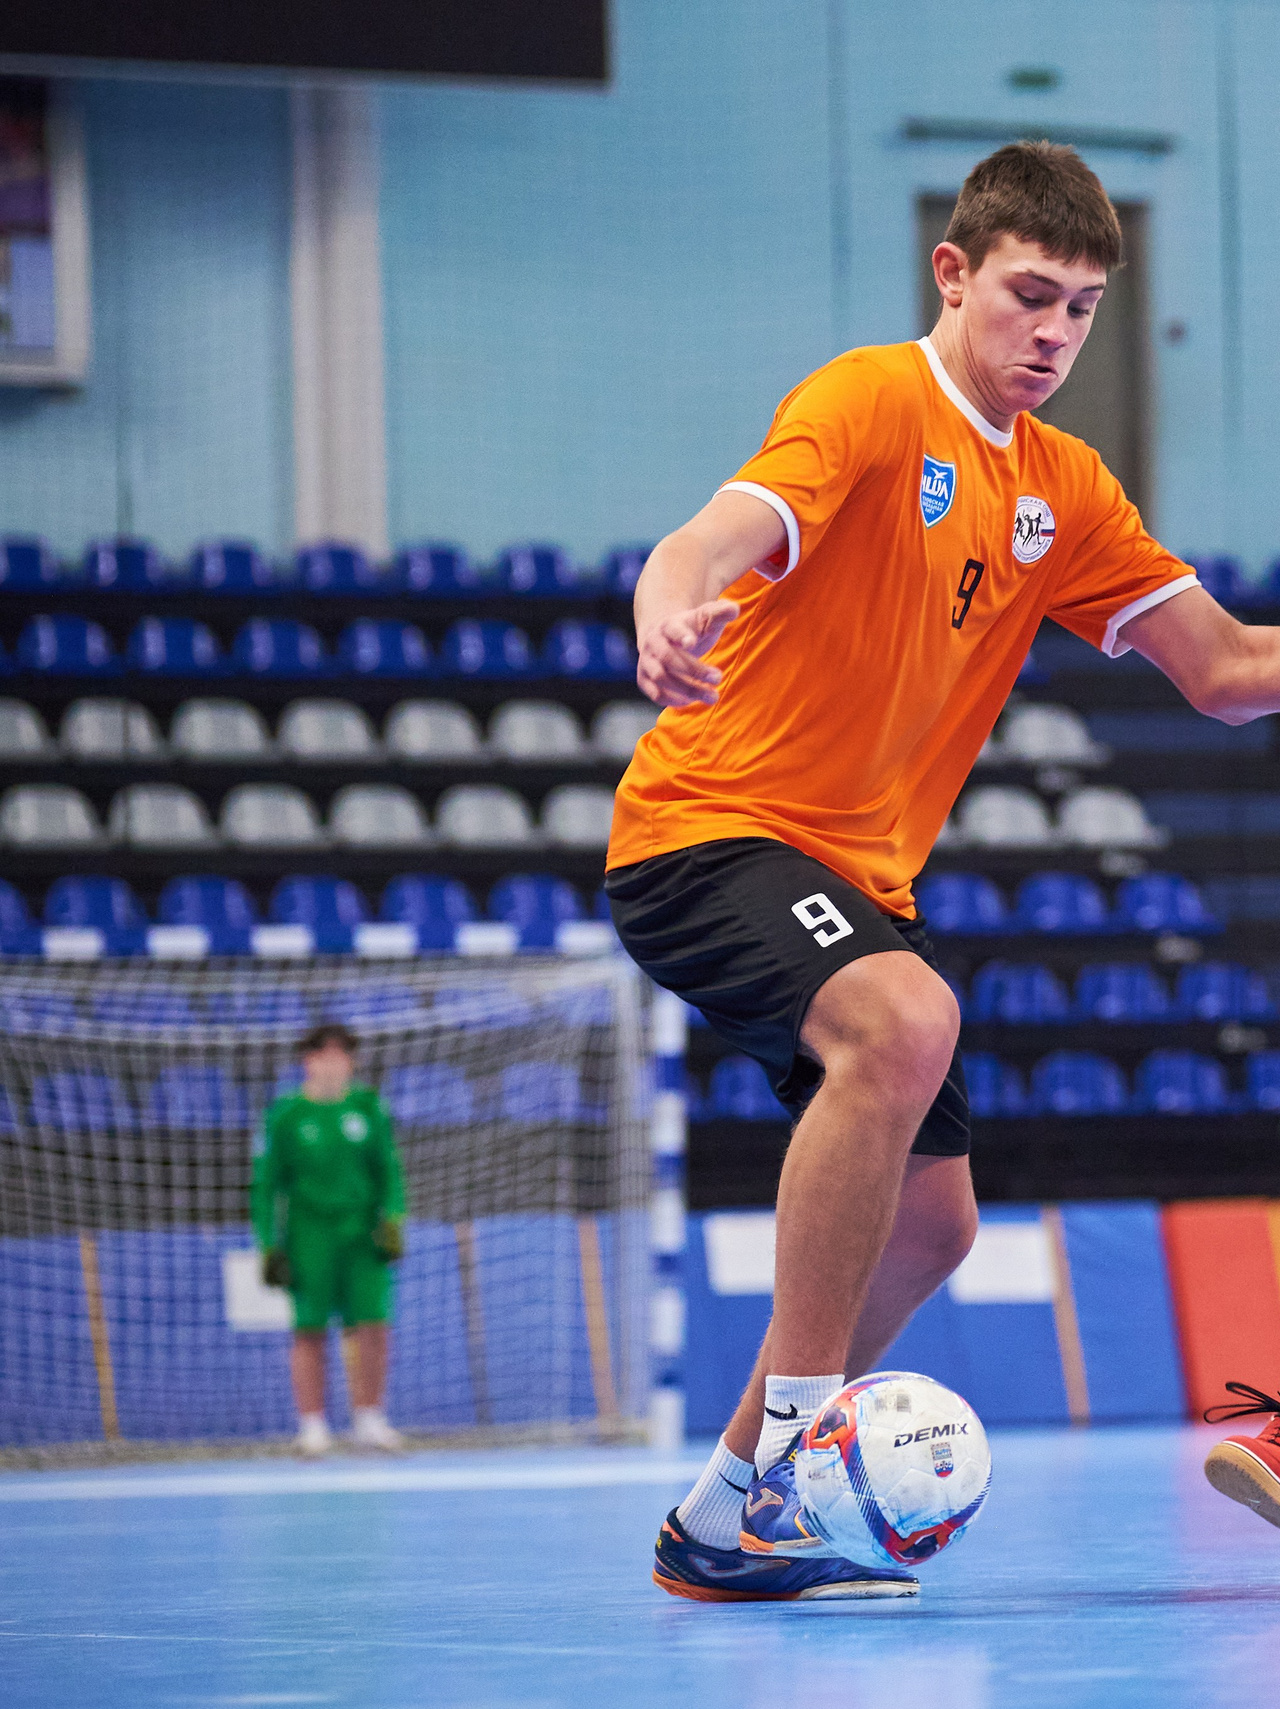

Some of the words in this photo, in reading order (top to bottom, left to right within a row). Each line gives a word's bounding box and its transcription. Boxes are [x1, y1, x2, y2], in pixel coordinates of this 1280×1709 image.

[952, 558, 985, 630] 9
[791, 892, 855, 948] 9
[893, 1422, 969, 1448] DEMIX
